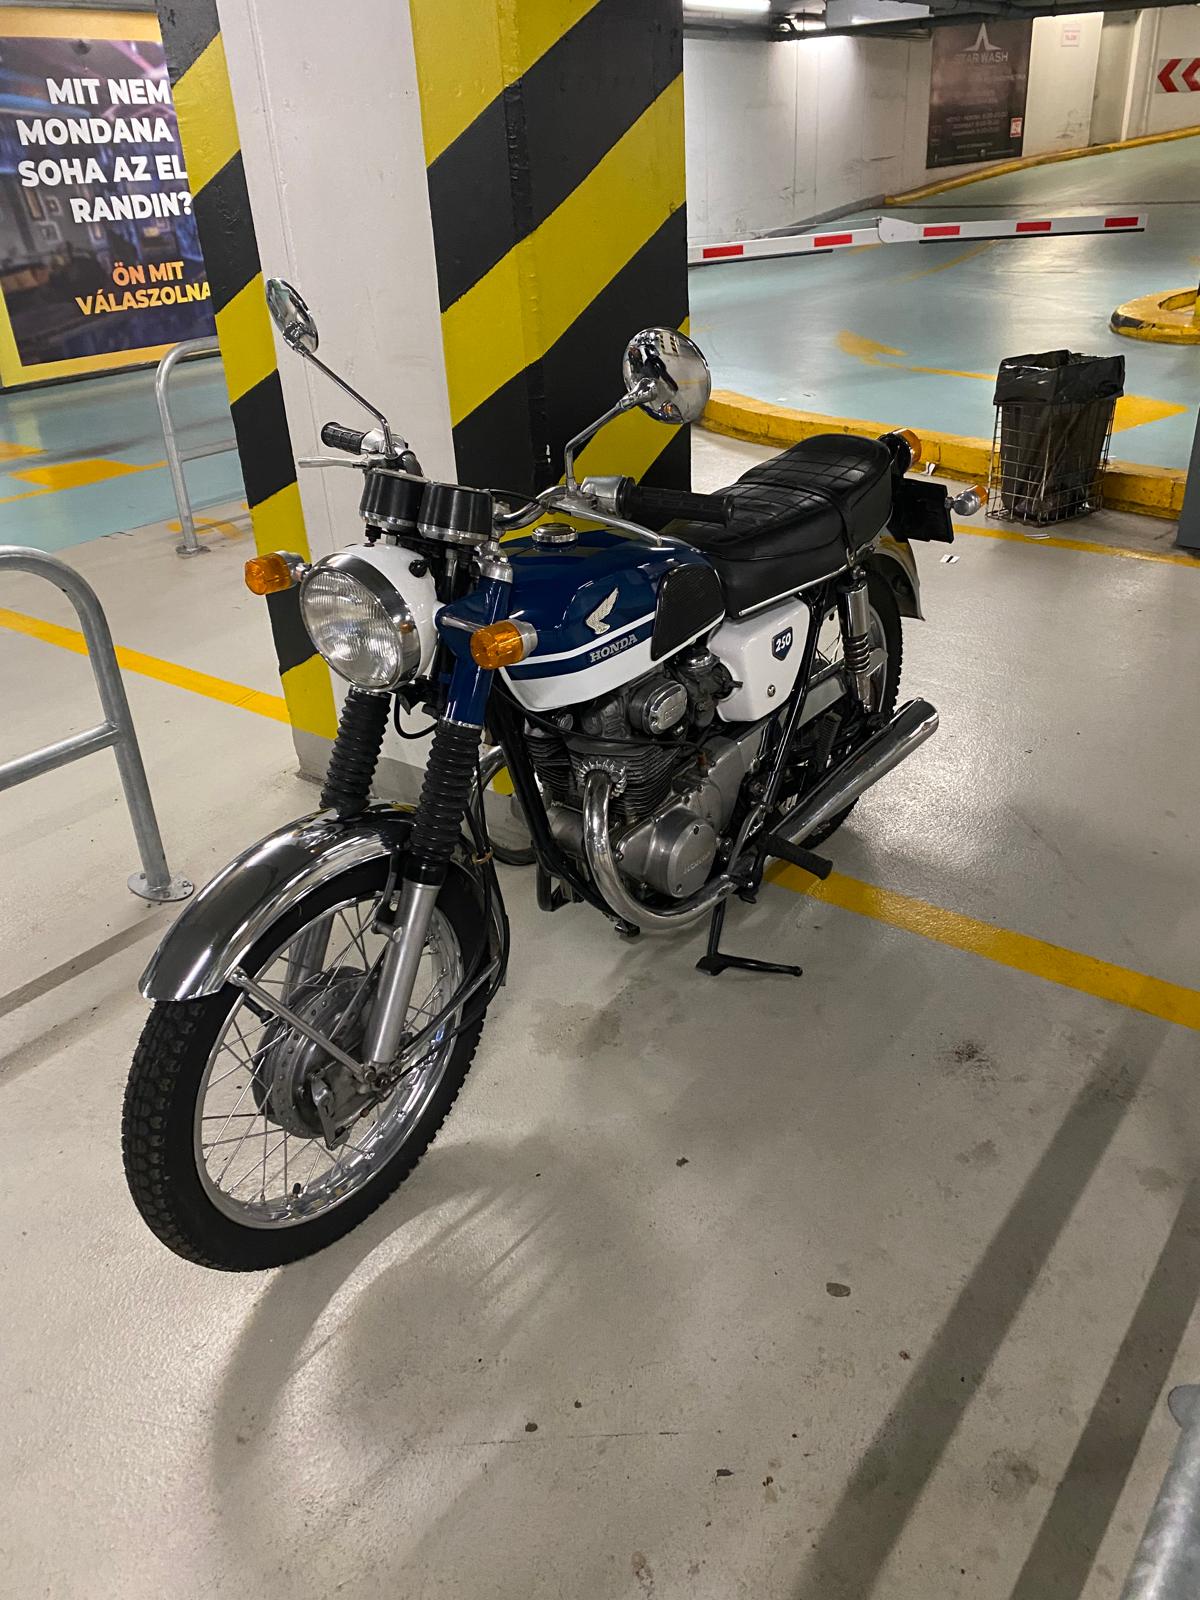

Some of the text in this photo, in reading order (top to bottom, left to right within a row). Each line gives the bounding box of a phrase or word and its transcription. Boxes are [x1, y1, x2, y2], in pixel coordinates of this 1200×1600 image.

[46, 78, 171, 105] MIT NEM
[16, 118, 174, 145] MONDANA
[19, 158, 107, 187] SOHA
[113, 155, 152, 182] AZ
[70, 191, 192, 223] RANDIN?
[112, 261, 184, 286] ÖN MIT
[75, 281, 211, 315] VÁLASZOLNA
[590, 633, 638, 662] HONDA
[775, 632, 792, 652] 250
